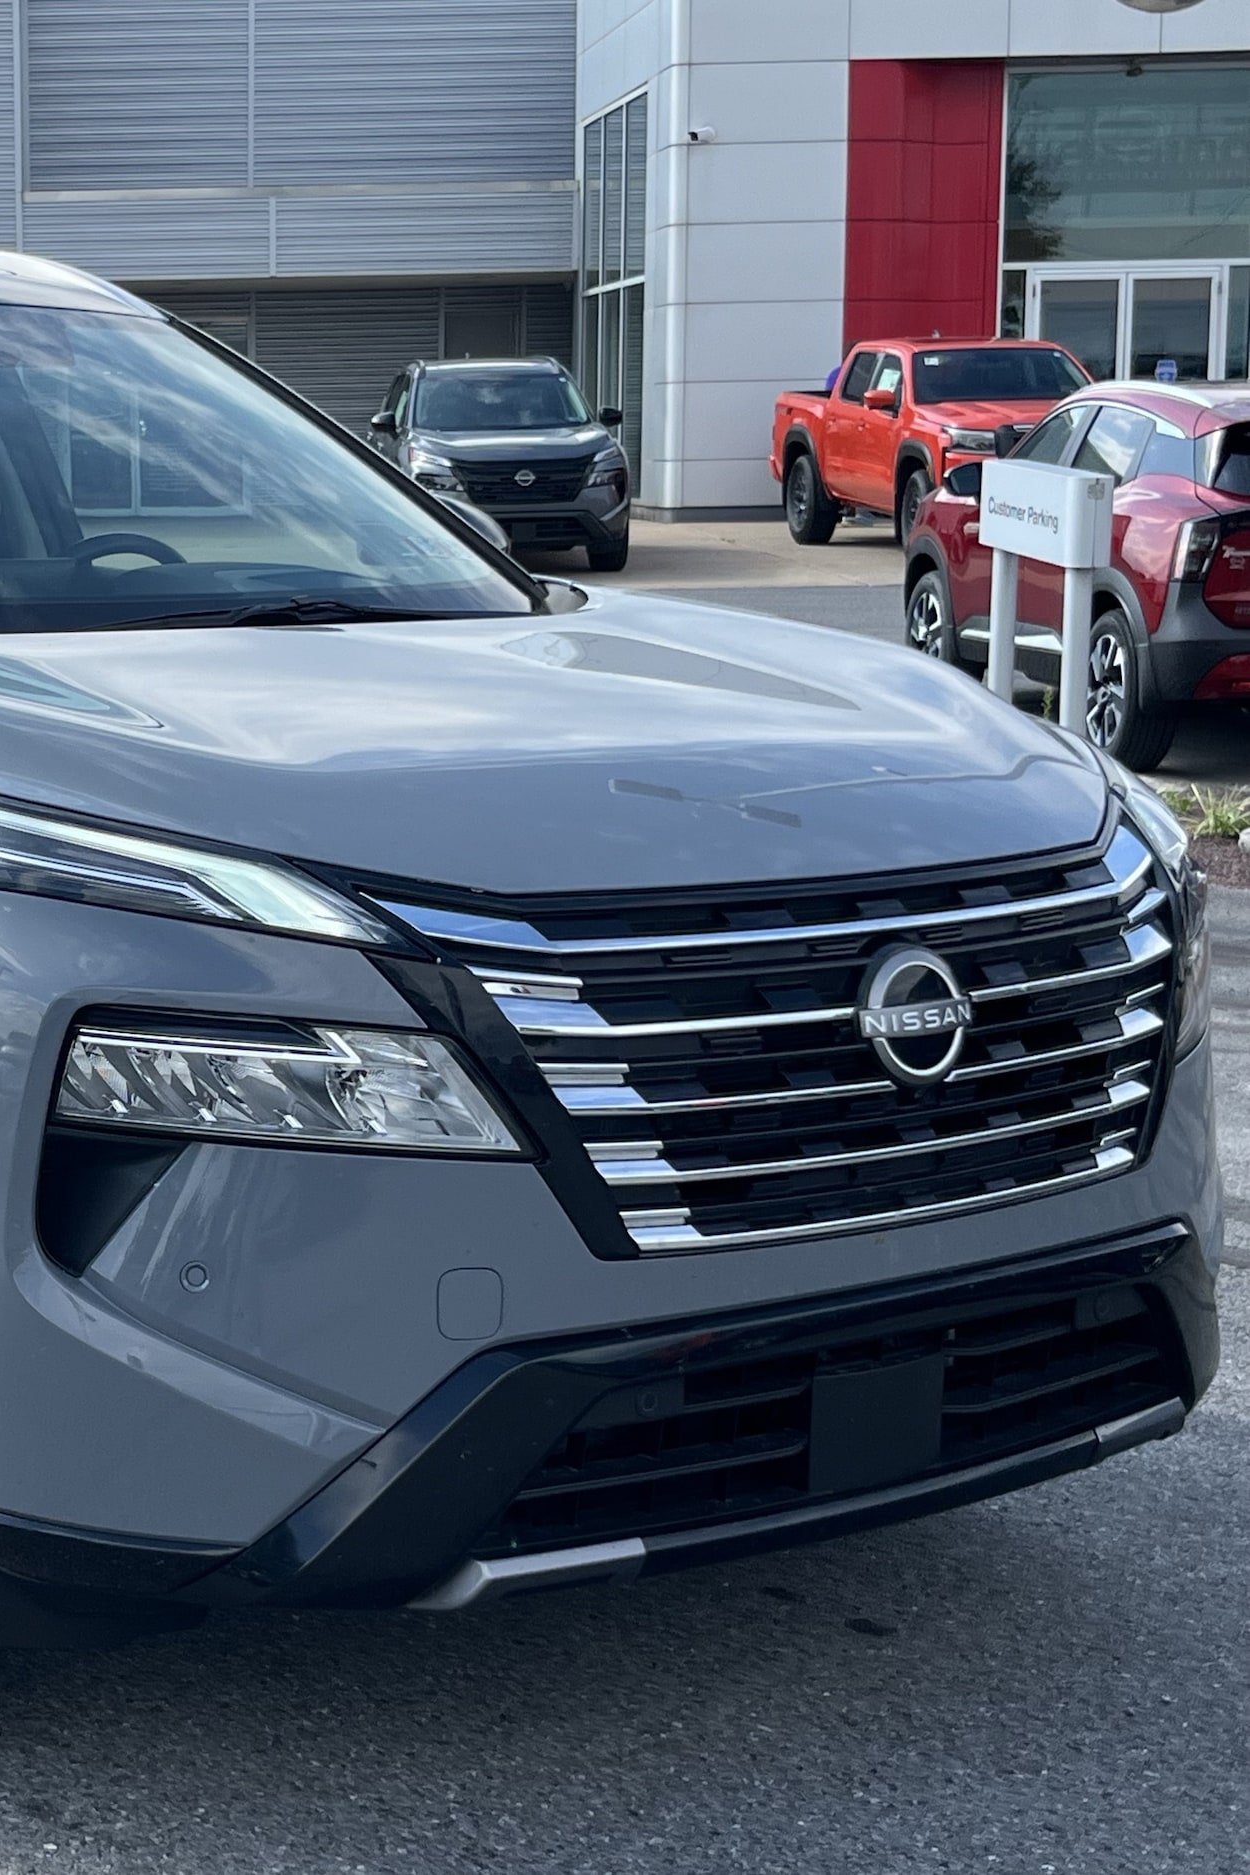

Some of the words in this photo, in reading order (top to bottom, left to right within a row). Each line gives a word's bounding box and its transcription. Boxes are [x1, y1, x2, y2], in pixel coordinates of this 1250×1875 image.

[988, 496, 1026, 522] Customer
[1027, 506, 1059, 534] Parking
[864, 1003, 971, 1033] NISSAN
